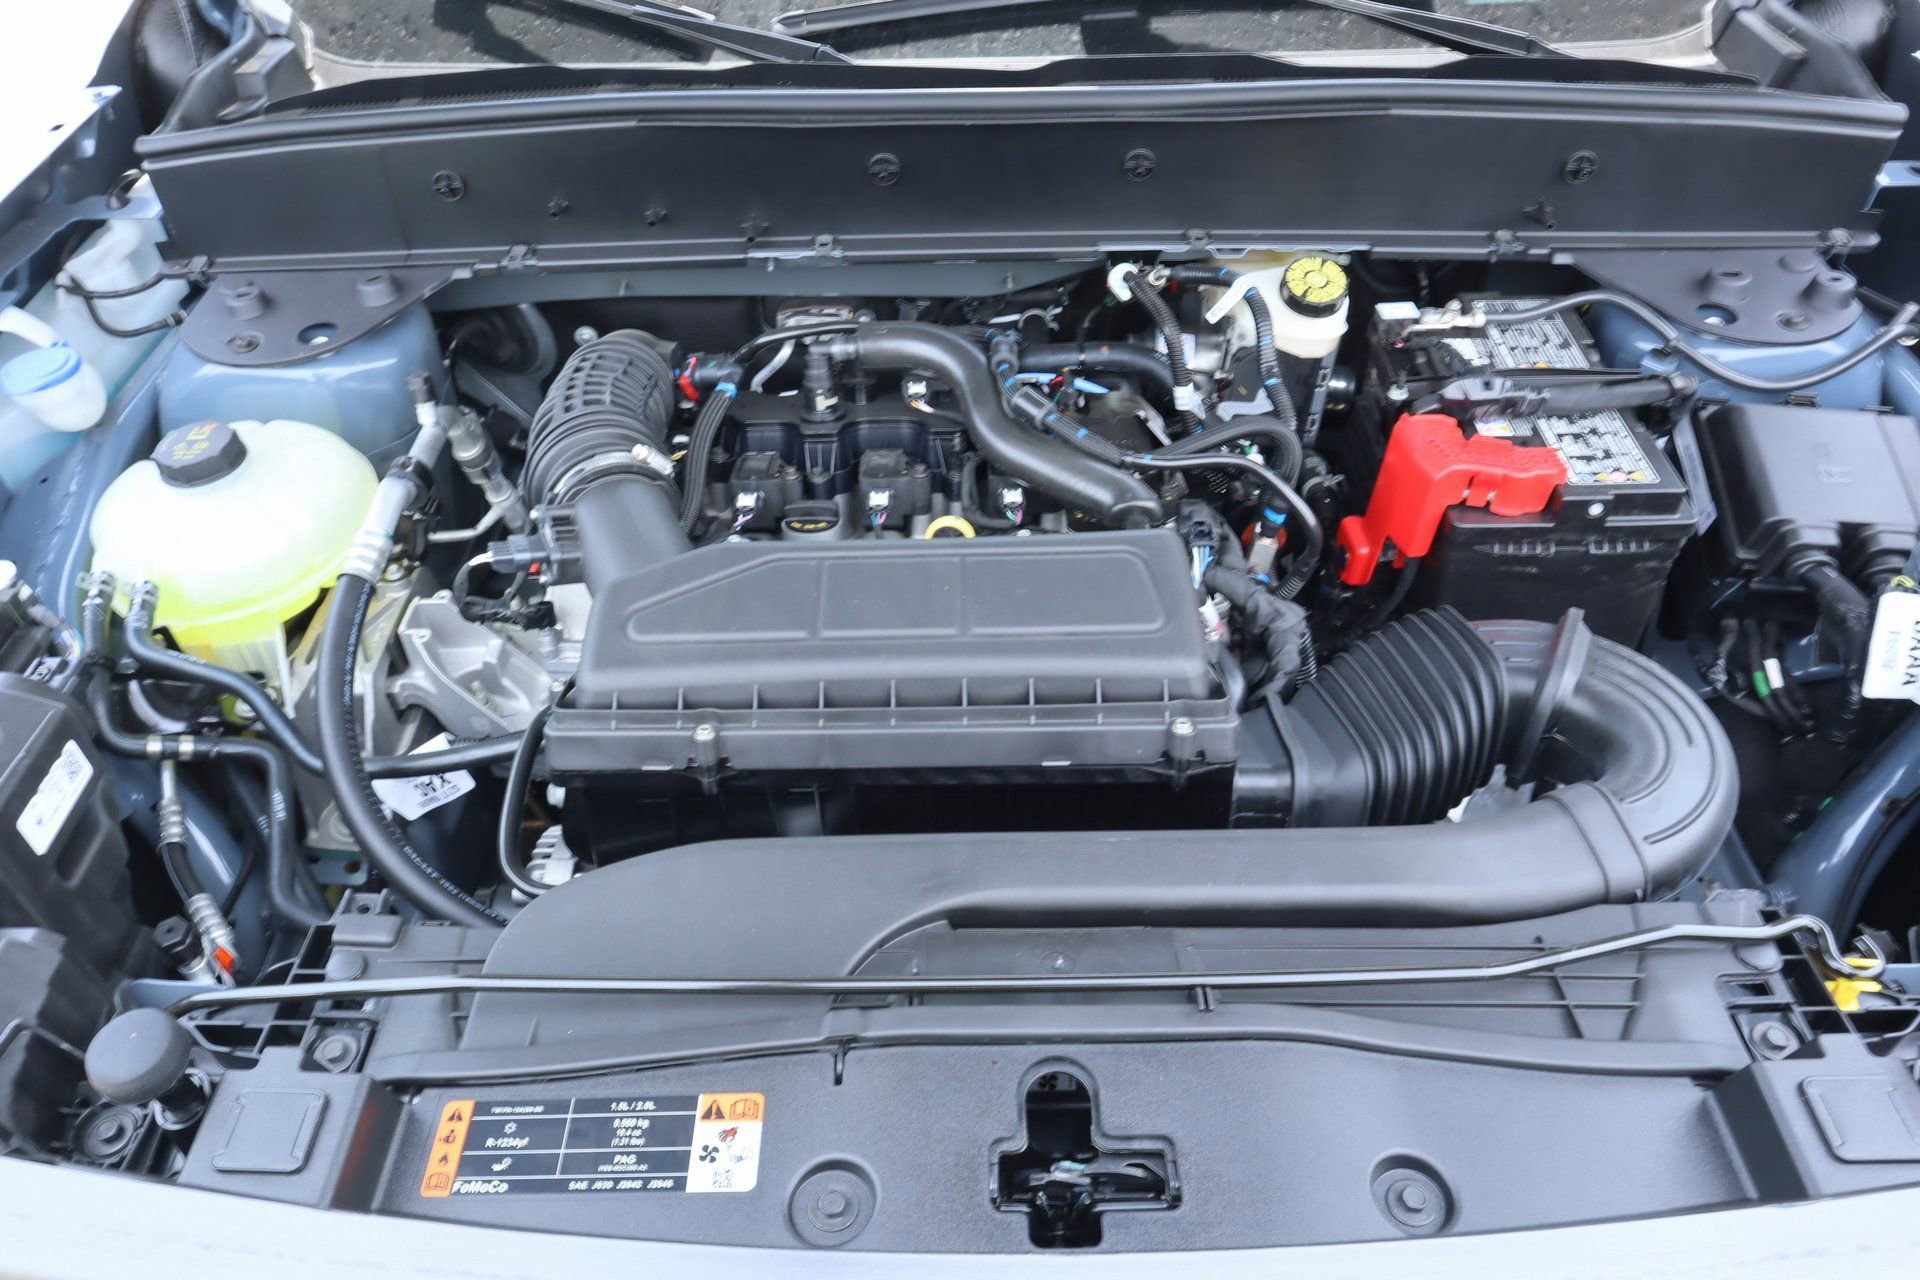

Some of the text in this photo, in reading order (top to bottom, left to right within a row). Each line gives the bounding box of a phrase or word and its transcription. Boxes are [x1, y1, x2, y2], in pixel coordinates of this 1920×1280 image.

[637, 1117, 650, 1129] kg
[485, 1137, 530, 1149] R-1234yf
[613, 1154, 637, 1165] PAG
[451, 1180, 509, 1193] FoMoCo
[568, 1181, 589, 1190] SAE
